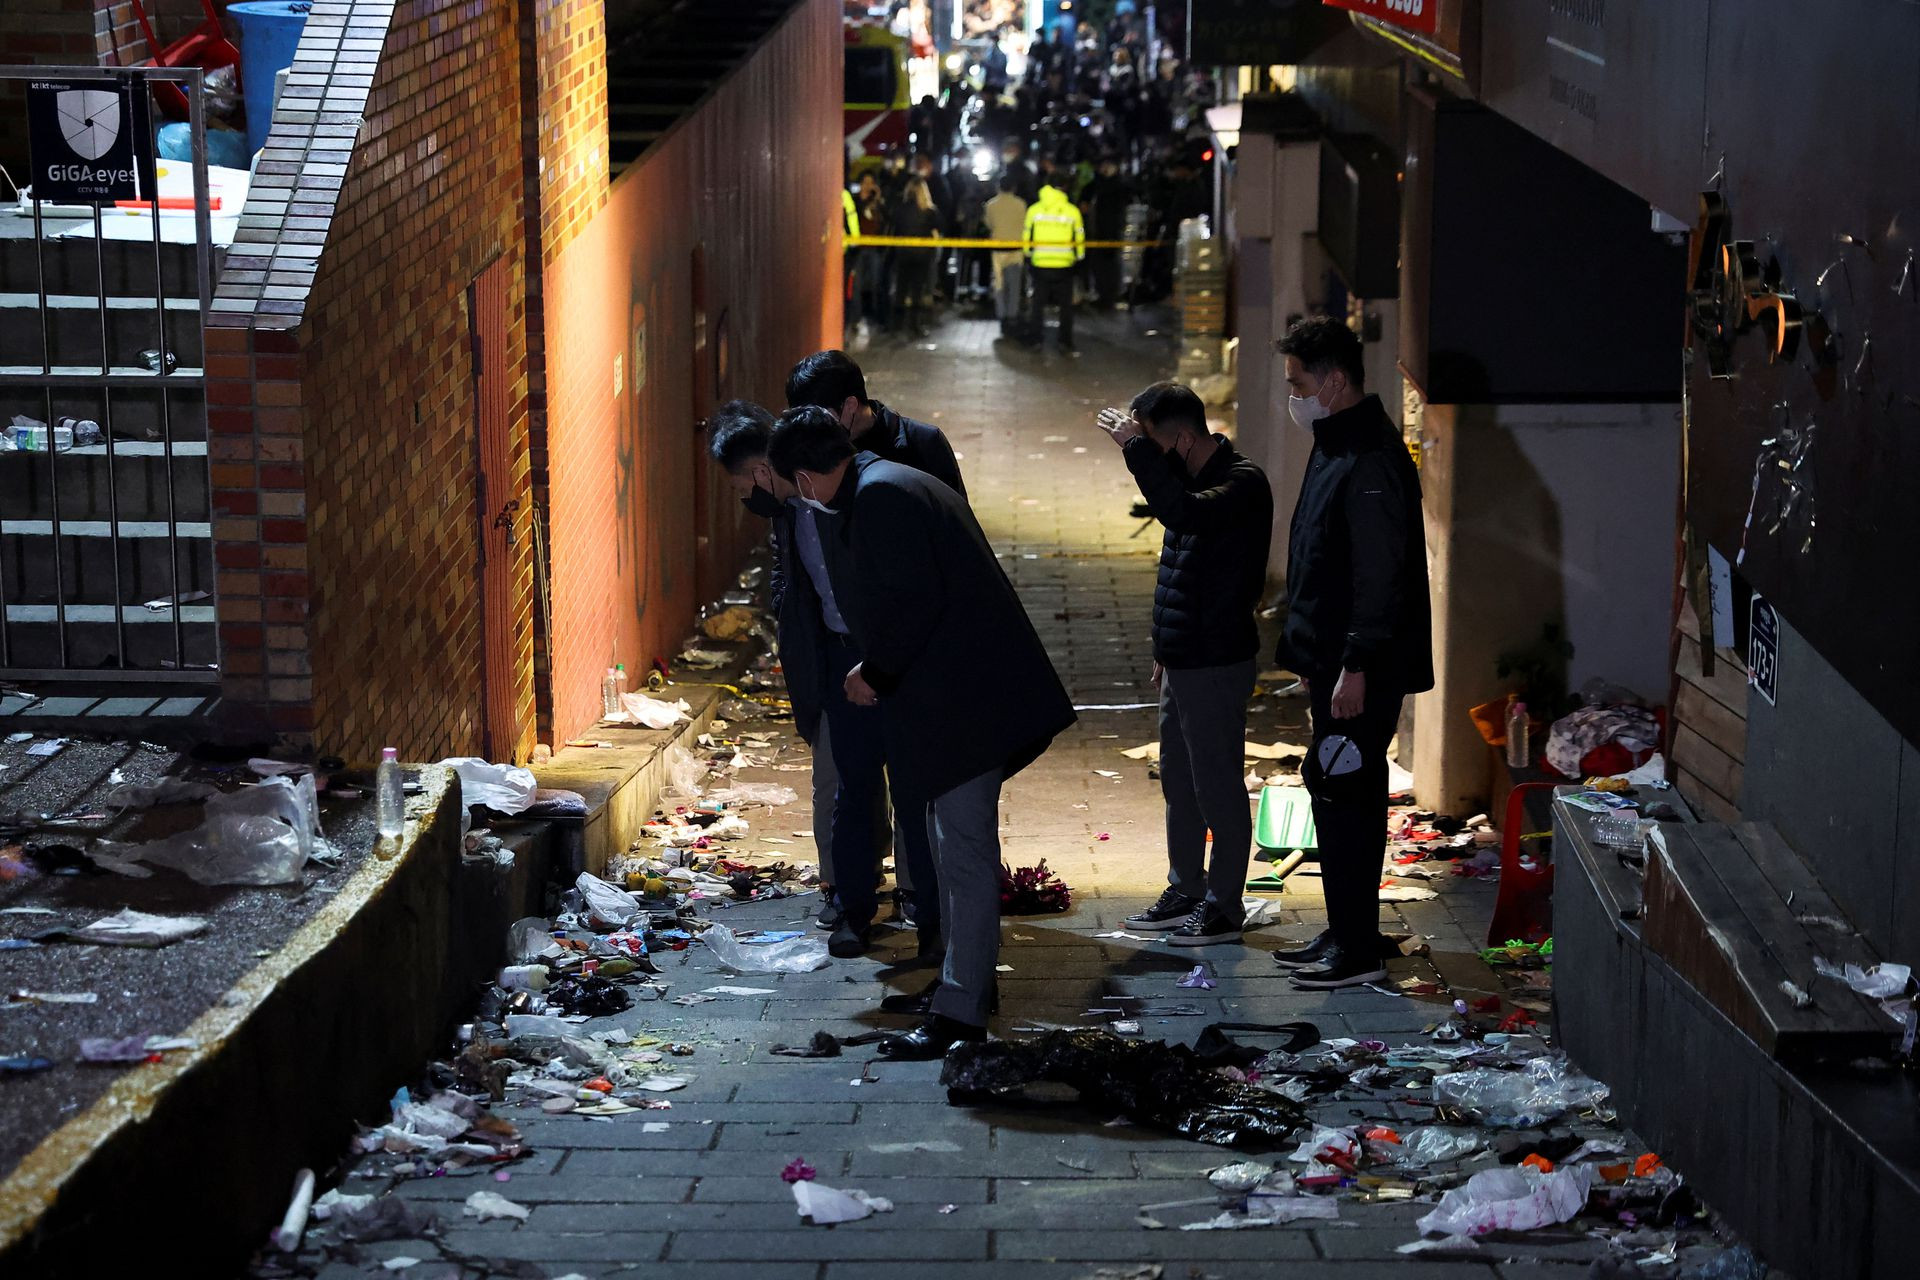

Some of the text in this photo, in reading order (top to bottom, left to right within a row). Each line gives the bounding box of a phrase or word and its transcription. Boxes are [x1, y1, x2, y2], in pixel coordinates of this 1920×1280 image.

[48, 164, 137, 185] GiGA eyes
[1752, 637, 1775, 687] 173-7
